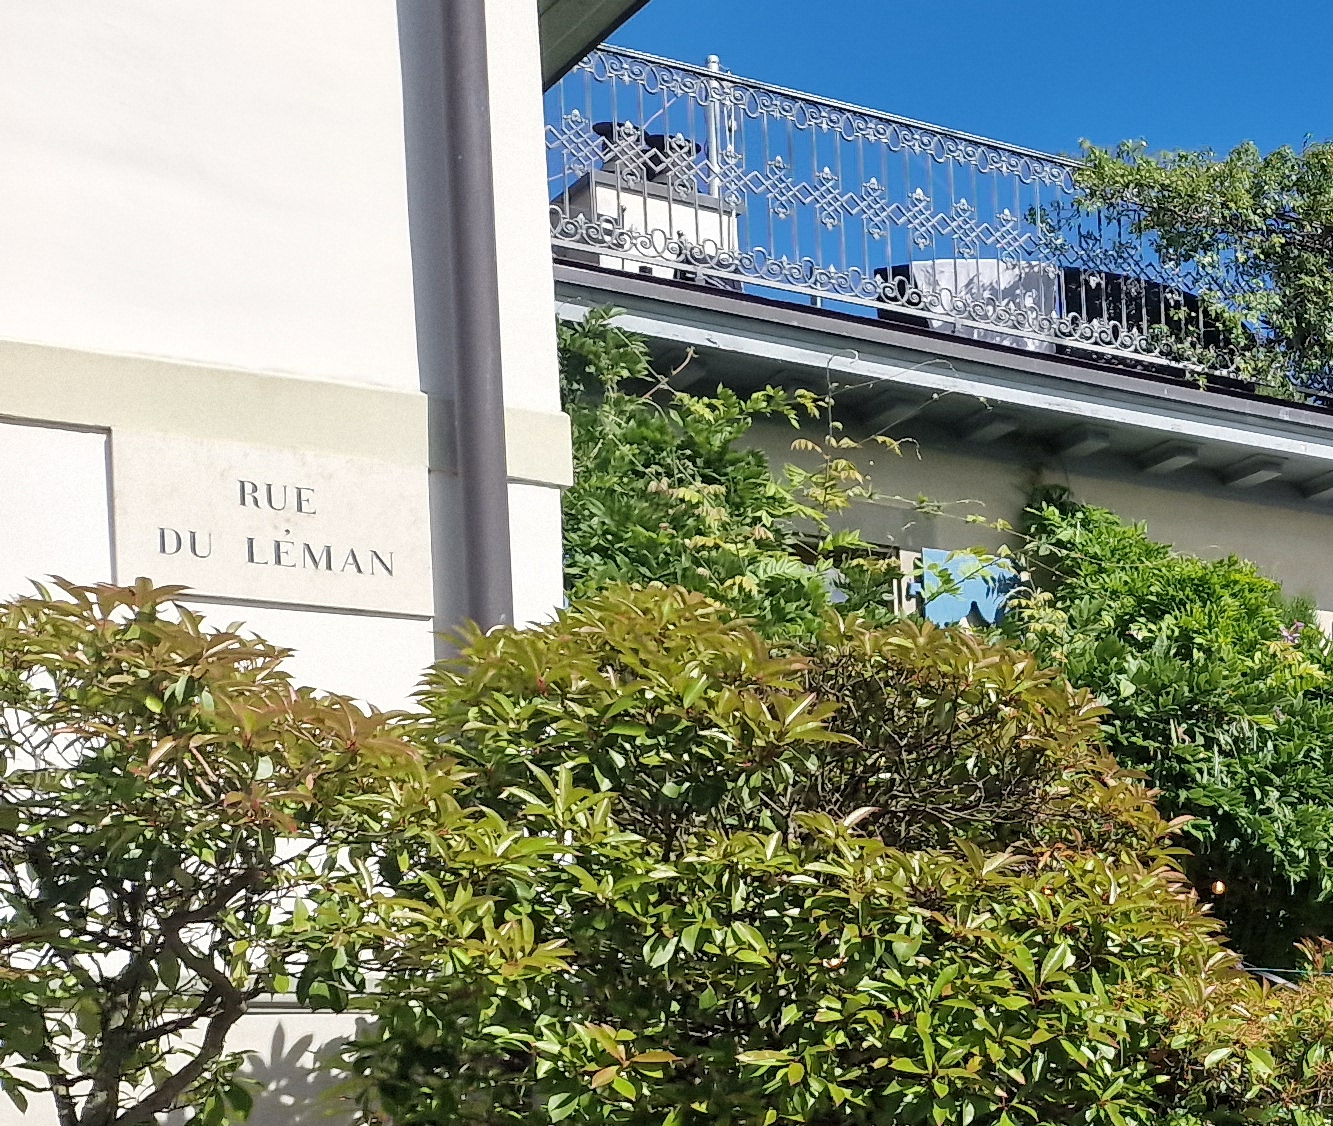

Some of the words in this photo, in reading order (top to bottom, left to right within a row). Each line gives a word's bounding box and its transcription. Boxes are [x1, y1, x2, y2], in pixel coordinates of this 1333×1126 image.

[237, 479, 317, 515] RUE
[158, 526, 212, 559] DU
[246, 528, 394, 577] LÉMAN
